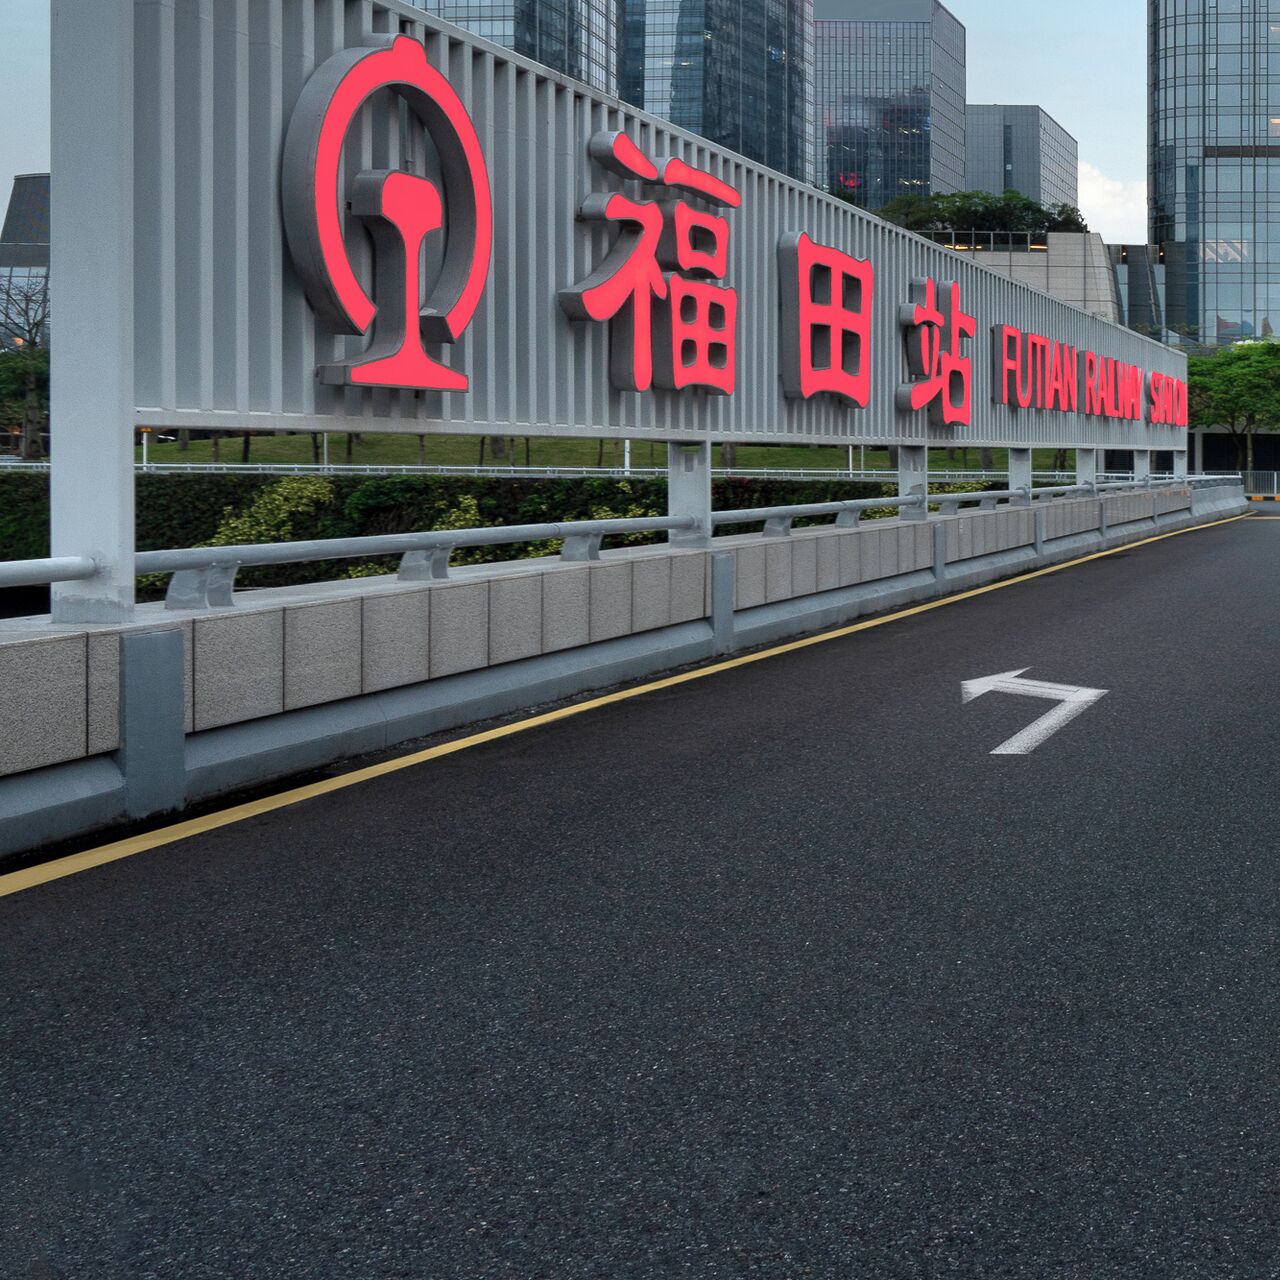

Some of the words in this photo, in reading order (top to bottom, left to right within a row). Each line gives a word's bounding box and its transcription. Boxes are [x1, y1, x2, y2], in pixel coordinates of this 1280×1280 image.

[580, 131, 978, 427] 福田站
[1001, 323, 1077, 413] FUTIAN
[1085, 350, 1144, 422] RAILWAY
